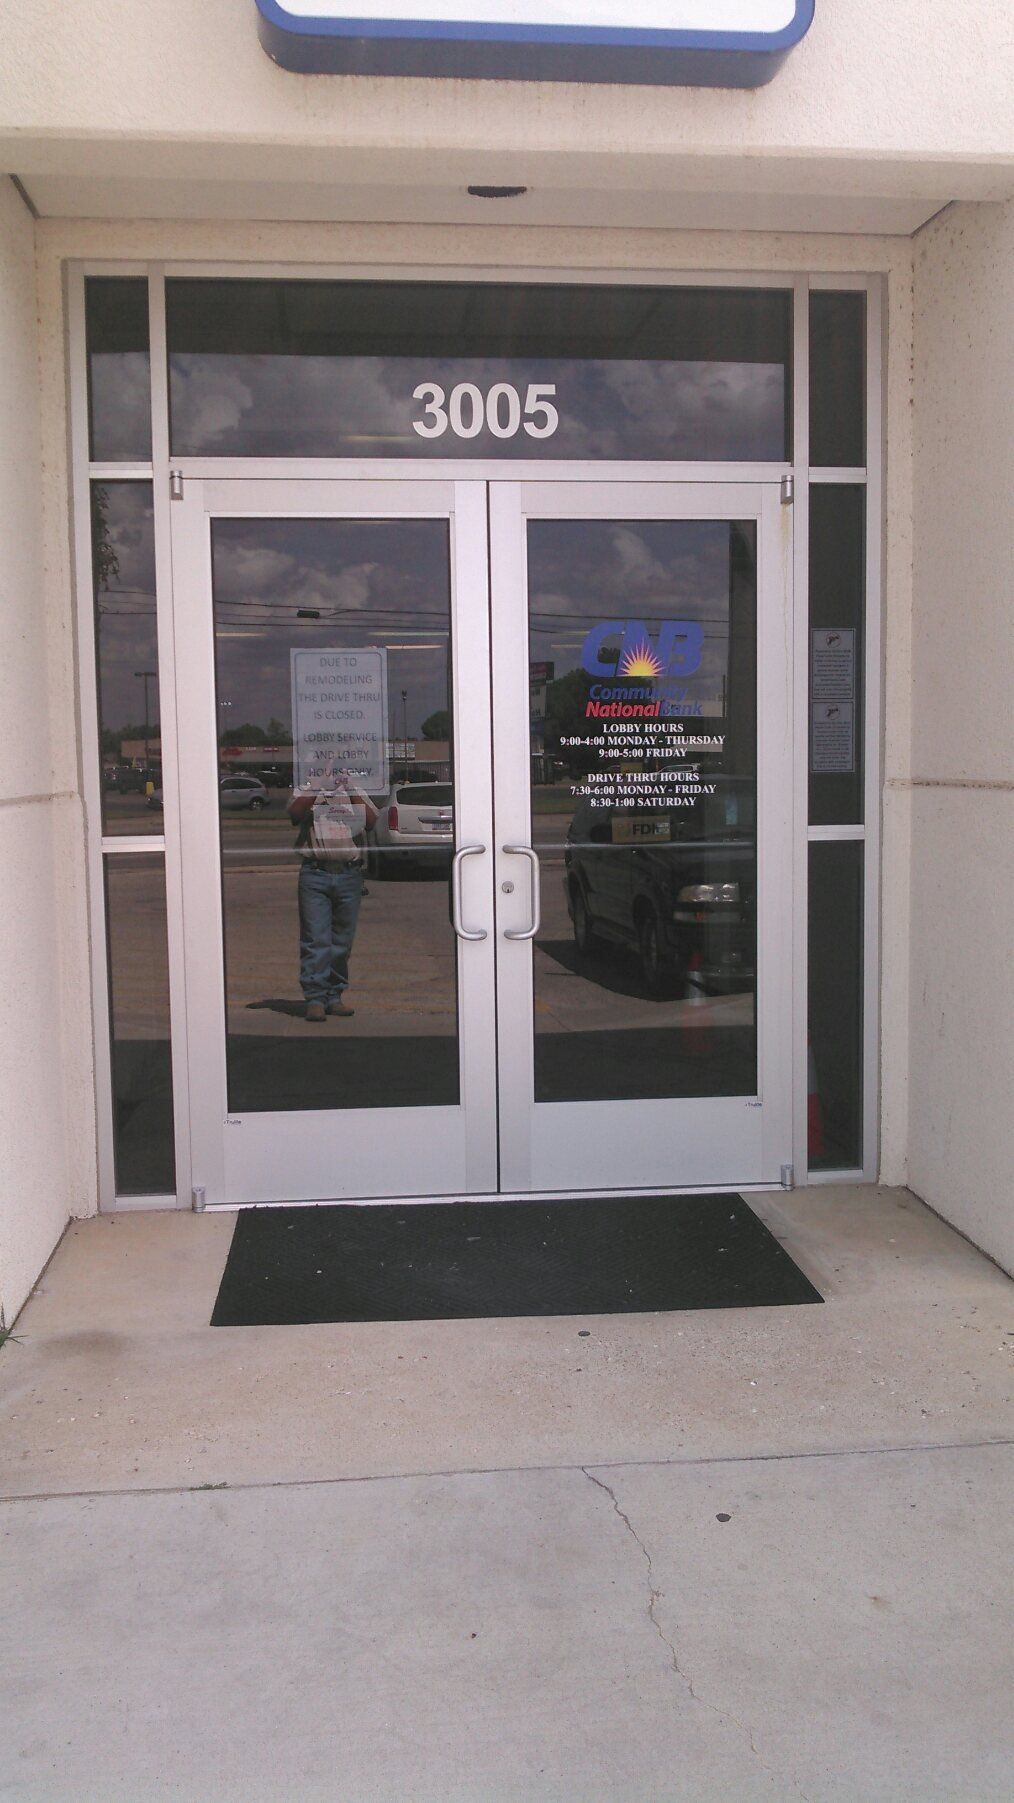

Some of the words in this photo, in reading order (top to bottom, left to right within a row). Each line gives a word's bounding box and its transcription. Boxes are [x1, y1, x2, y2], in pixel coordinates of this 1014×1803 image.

[413, 382, 559, 439] 3005
[581, 621, 705, 677] CNB
[320, 657, 340, 668] DUE
[344, 657, 357, 667] TO
[305, 675, 373, 685] REMODELING
[300, 693, 317, 702] THE
[320, 693, 350, 702] DRIVE
[353, 692, 380, 702] THRU
[314, 710, 322, 720] IS
[325, 710, 366, 720] CLOSED.
[603, 723, 642, 734] LOBBY
[644, 723, 684, 733] HOURS
[303, 733, 335, 742] LOBBY
[337, 732, 377, 742] SERVICE
[560, 736, 605, 746] 9:00-4:00
[607, 736, 658, 746] MONDAY
[665, 735, 725, 745] THURSDAY
[313, 750, 335, 760] AND
[338, 750, 369, 760] LOBBY
[599, 749, 644, 758] 9:00-5:00
[646, 748, 687, 757] FRIDAY
[308, 768, 343, 777] HOURS
[587, 773, 623, 783] DRIVE
[624, 773, 658, 782] THRU
[660, 772, 700, 782] HOURS
[570, 786, 615, 795] 7:30-6:00
[617, 785, 667, 795] MONDAY
[675, 785, 716, 794] FRIDAY
[590, 798, 635, 807] 8:30-1:00
[637, 797, 696, 807] SATURDAY
